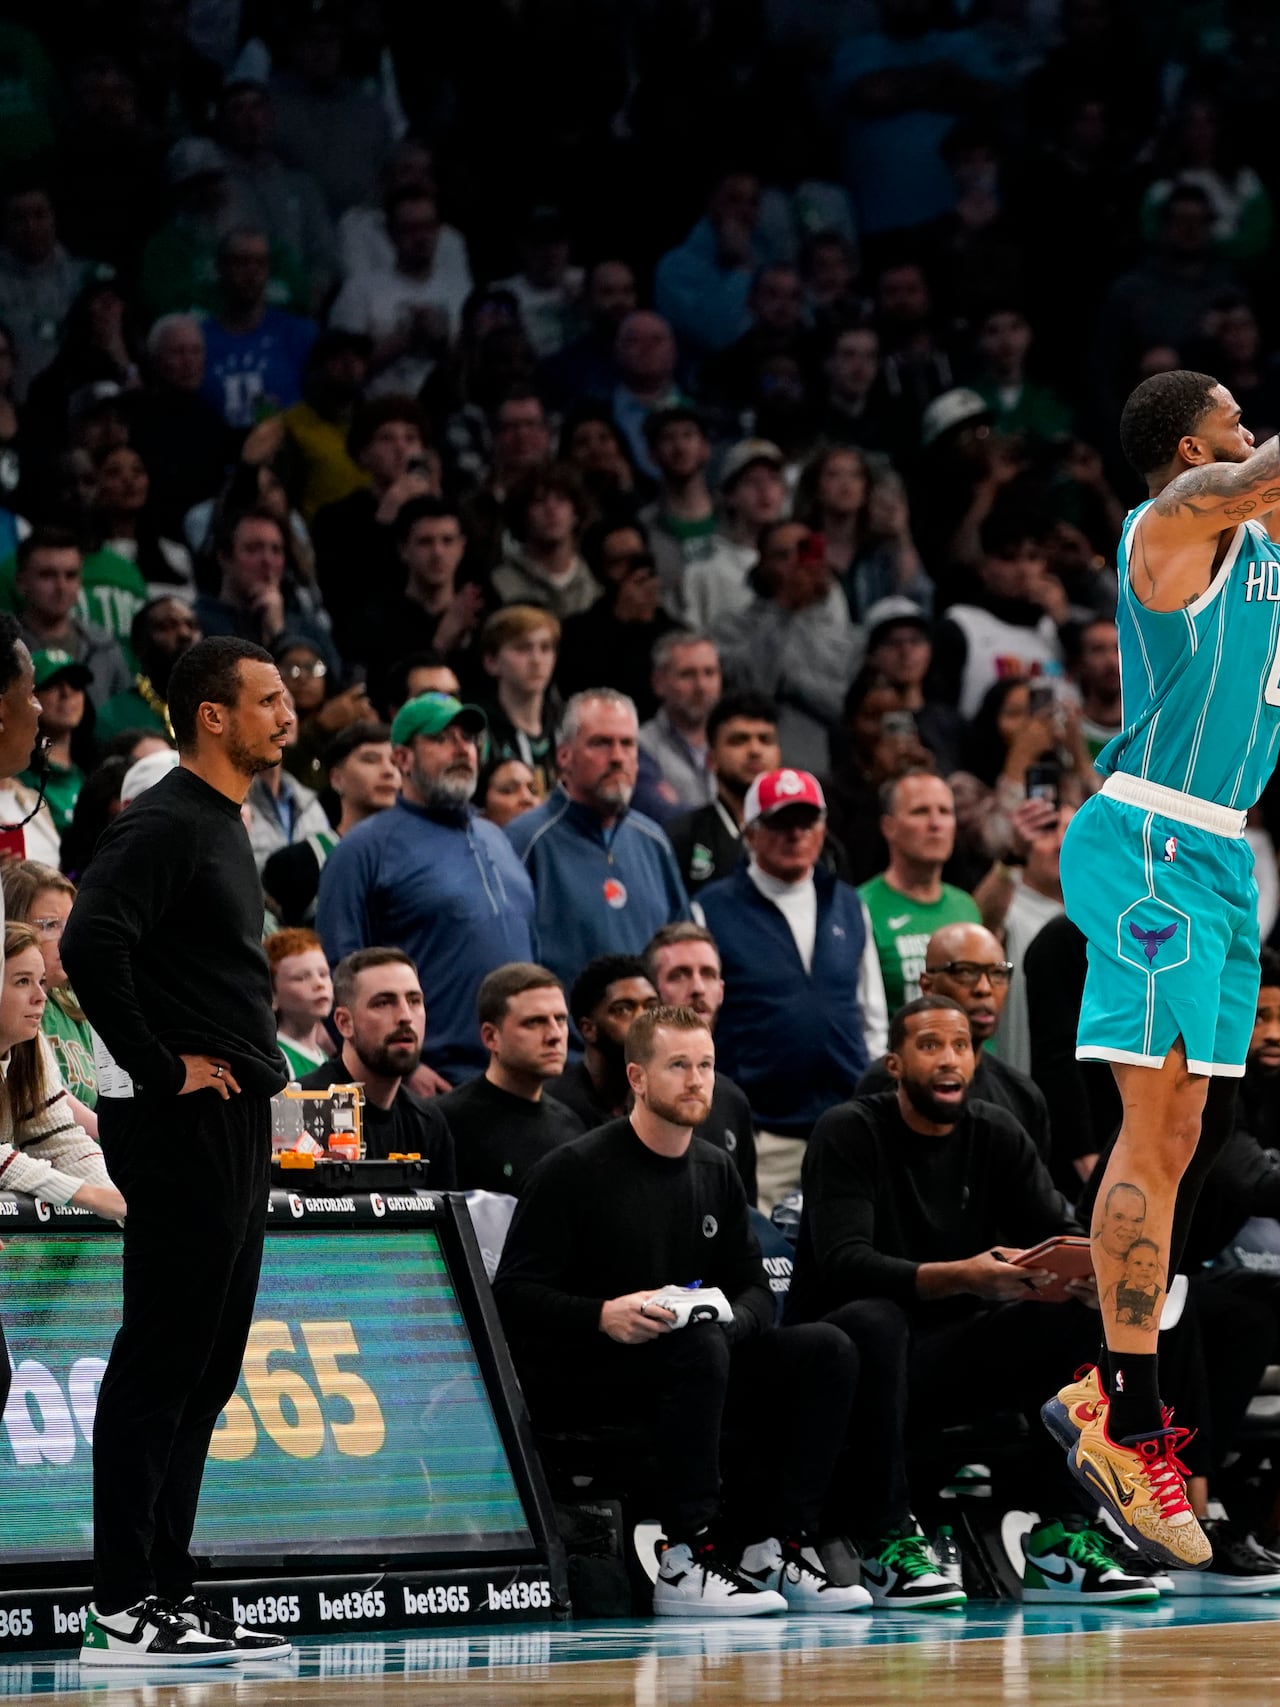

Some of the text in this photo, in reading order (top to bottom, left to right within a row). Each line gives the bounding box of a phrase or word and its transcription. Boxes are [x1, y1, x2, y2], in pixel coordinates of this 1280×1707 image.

[305, 1197, 356, 1213] GATORADE
[387, 1196, 436, 1212] GATORADE
[318, 1591, 386, 1620] bet365
[402, 1586, 470, 1614] bet365
[487, 1581, 551, 1610] bet365
[232, 1595, 300, 1625] bet365
